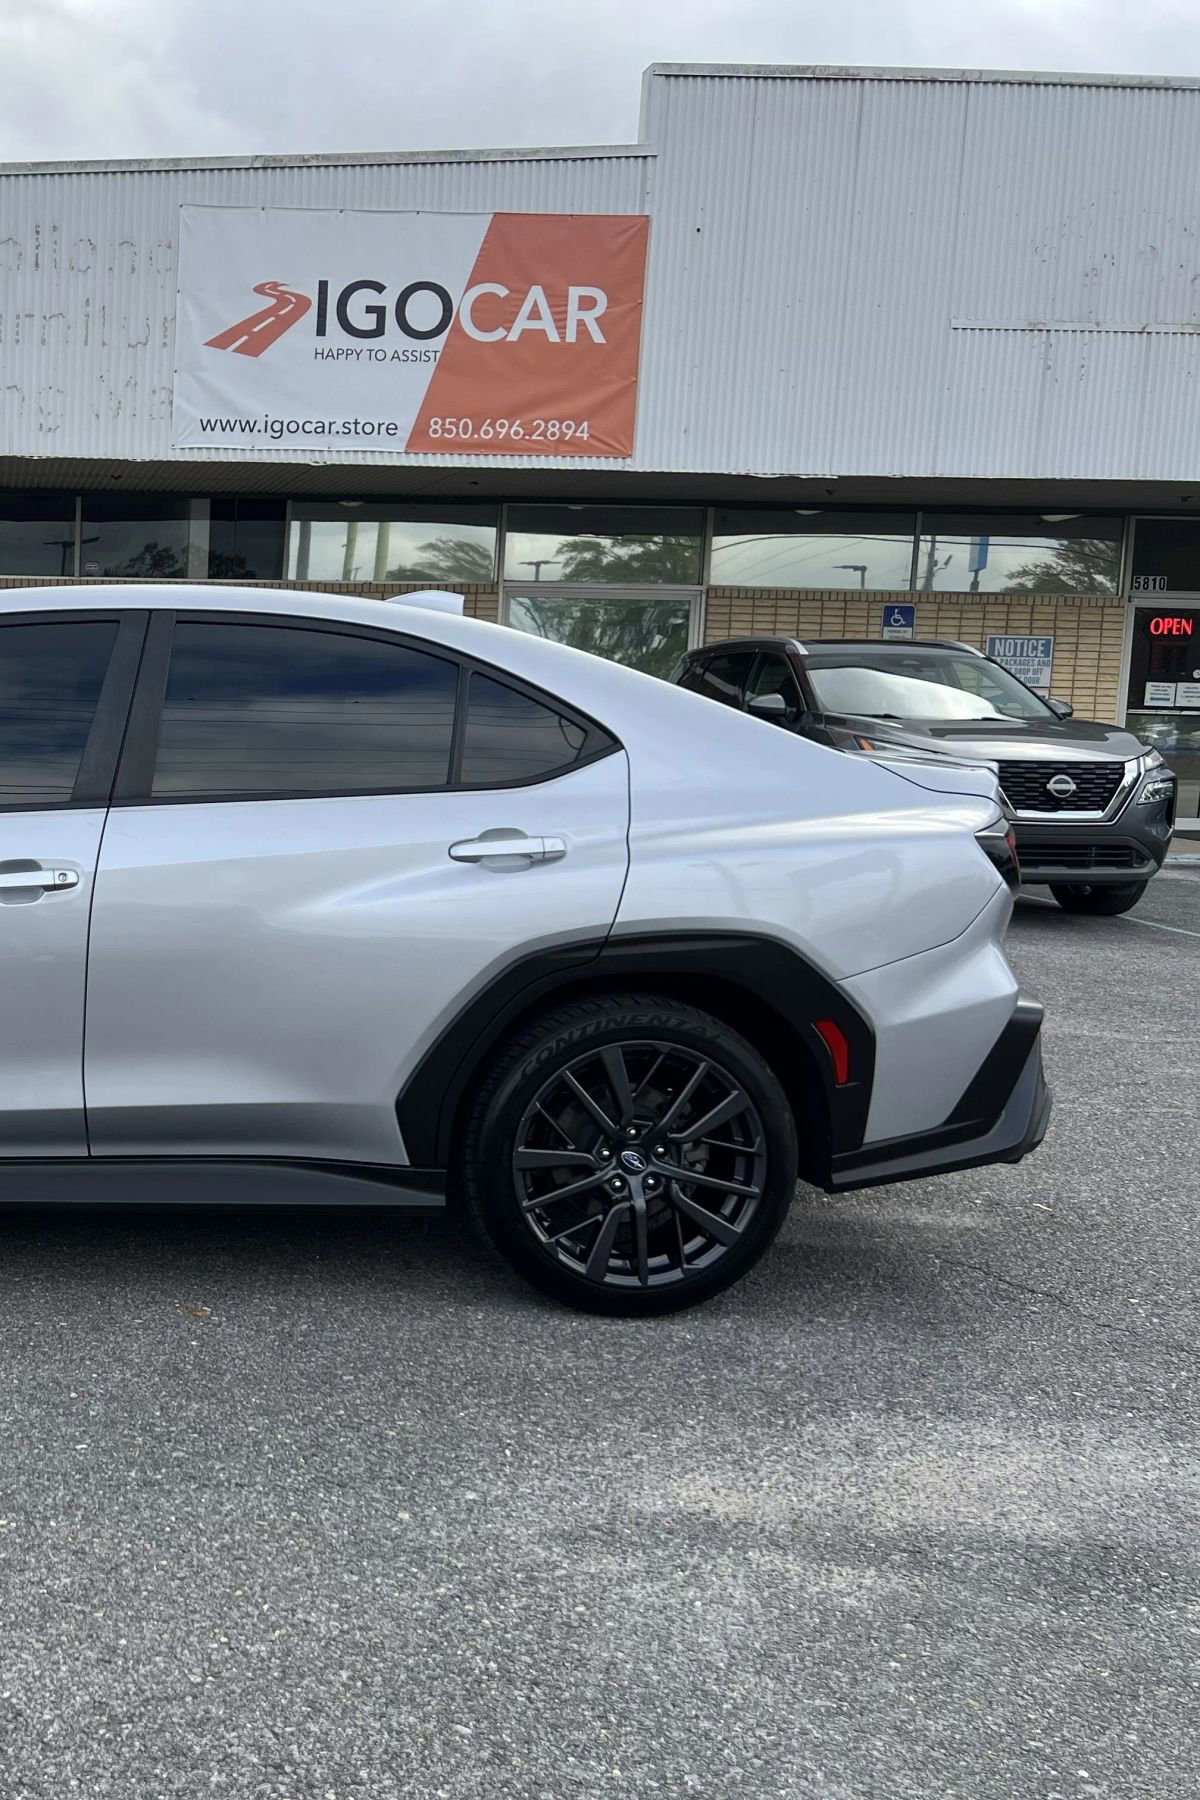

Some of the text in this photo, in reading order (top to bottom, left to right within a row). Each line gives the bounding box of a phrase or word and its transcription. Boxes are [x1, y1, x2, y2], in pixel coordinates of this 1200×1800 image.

[315, 279, 608, 344] IGOCAR
[314, 347, 440, 363] HAPPY TO ASSIST
[199, 414, 399, 440] www.igocar.store
[428, 416, 590, 442] 850.696.2894
[1134, 576, 1167, 591] 5810
[1150, 617, 1193, 636] OPEN
[993, 638, 1046, 657] NOTICE
[1000, 657, 1051, 668] PACKAGES AND
[1013, 667, 1031, 676] DROP
[521, 1013, 723, 1079] CONTINENTAL
